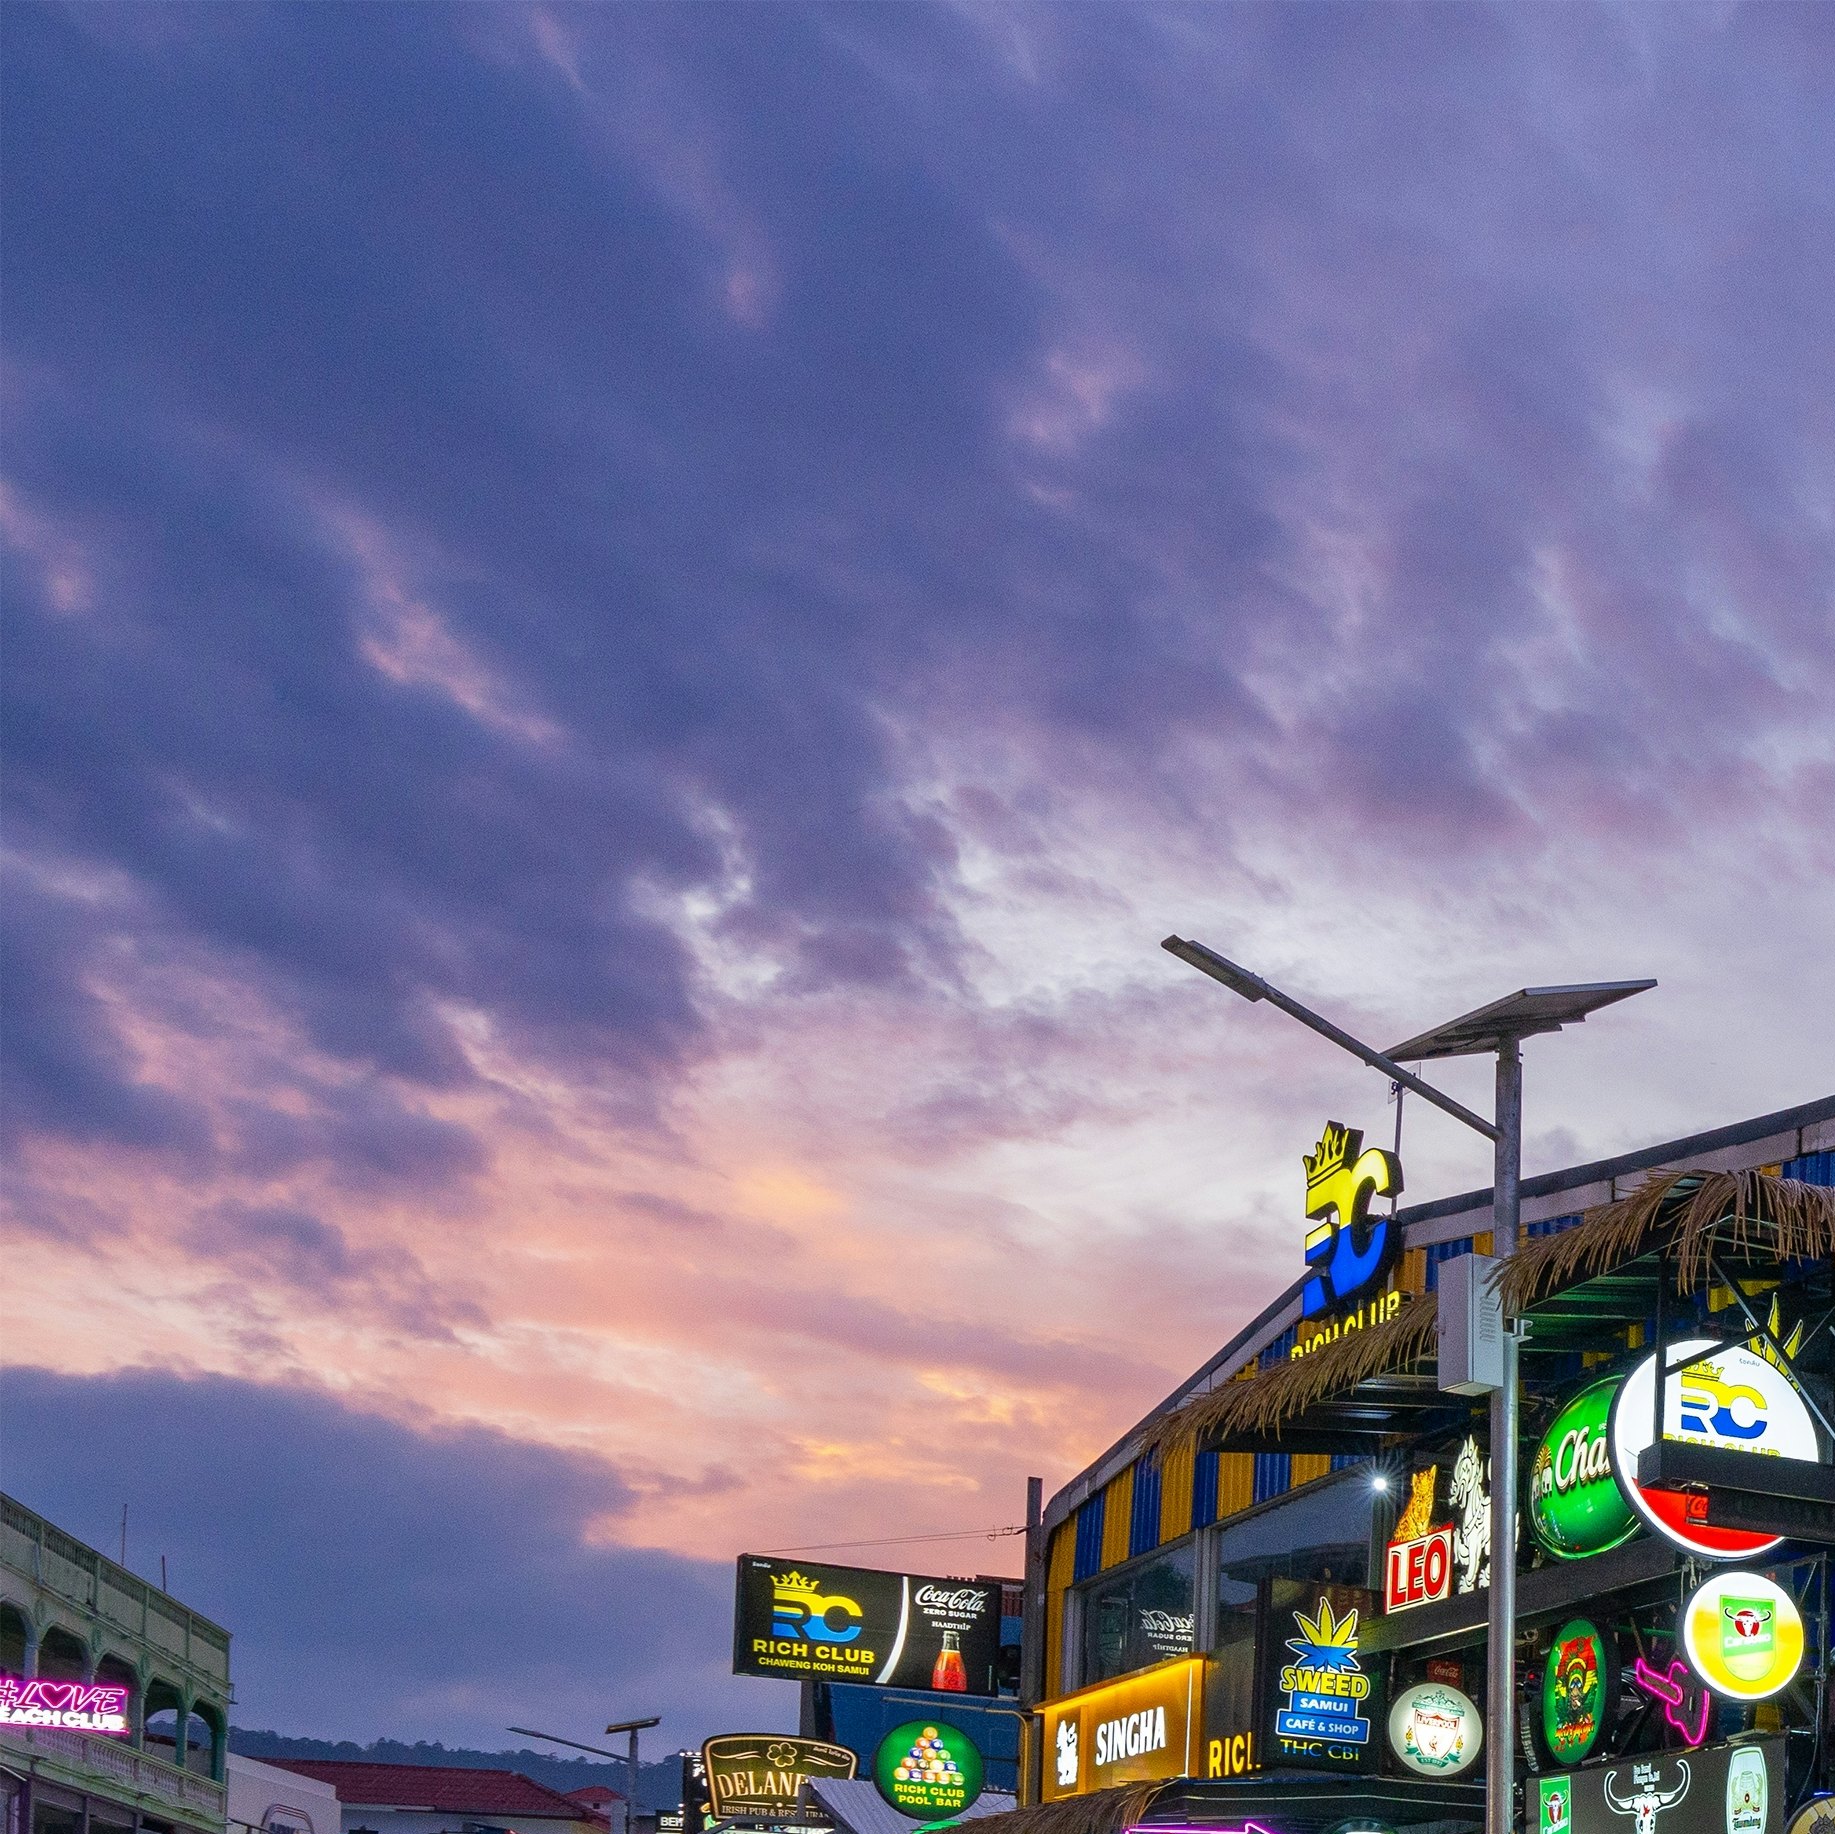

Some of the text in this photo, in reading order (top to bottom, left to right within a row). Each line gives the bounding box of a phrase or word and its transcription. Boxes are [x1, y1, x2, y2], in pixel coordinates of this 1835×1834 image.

[1388, 1533, 1449, 1608] LEO
[914, 1584, 988, 1613] Coca-Cola
[923, 1608, 978, 1619] ZERO SUGAR
[752, 1637, 876, 1665] RICH CLUB
[757, 1656, 870, 1676] CHAWENG KOH SAMUI
[1280, 1665, 1370, 1701] SWEED
[1299, 1697, 1349, 1713] SAMUI
[62, 1711, 126, 1731] CLUB
[1285, 1716, 1360, 1735] CAFÉ & SHOP
[1095, 1705, 1167, 1767] SINGHA
[1280, 1737, 1323, 1758] THC
[894, 1784, 965, 1799] RICH CLUB
[898, 1795, 962, 1808] POOL BAR
[722, 1805, 776, 1817] IRISH PUB &
